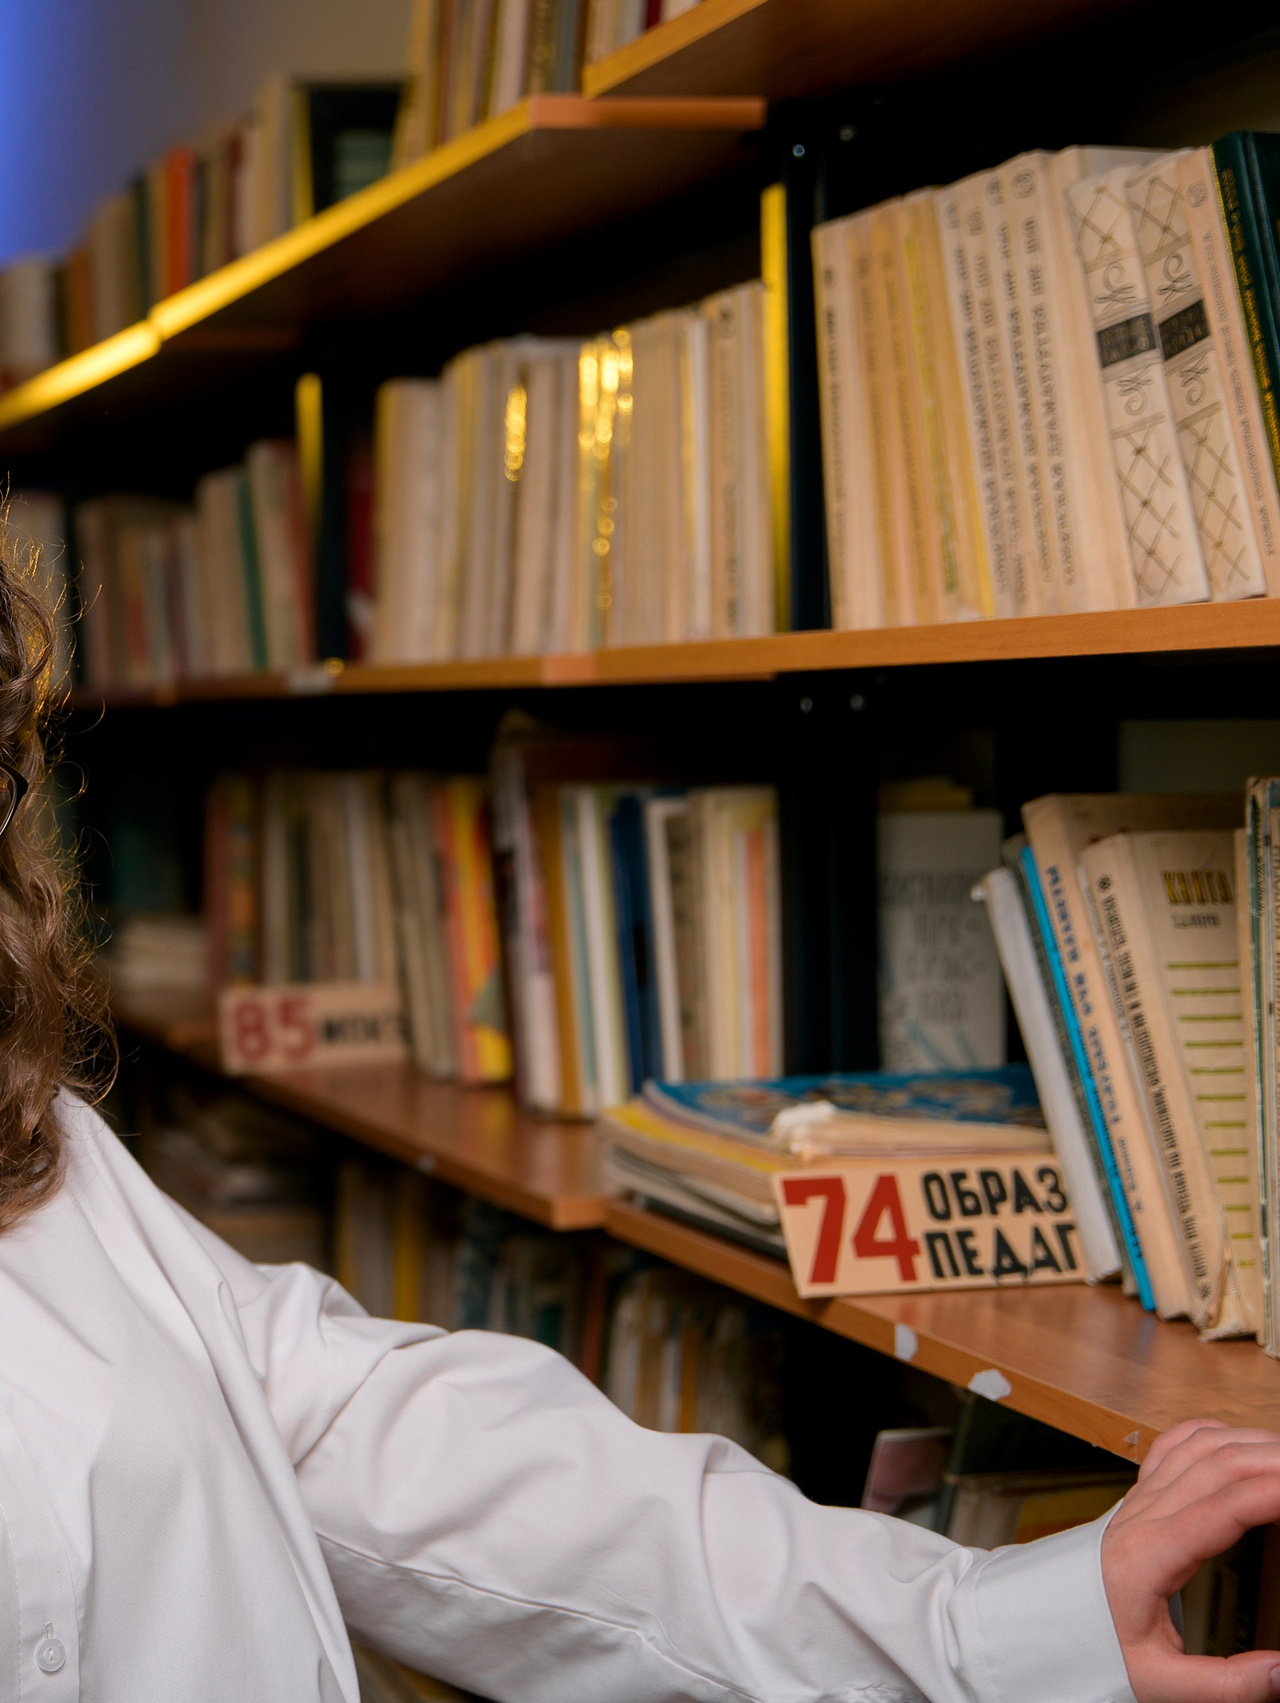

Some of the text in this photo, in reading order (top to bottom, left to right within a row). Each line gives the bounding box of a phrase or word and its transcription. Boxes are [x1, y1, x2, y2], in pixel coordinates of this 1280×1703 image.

[1161, 869, 1234, 906] КНИГА
[233, 999, 317, 1062] 85
[923, 1167, 1068, 1221] ОБРАЗ
[781, 1174, 921, 1284] 74
[925, 1221, 1078, 1284] ПЕДАГ
